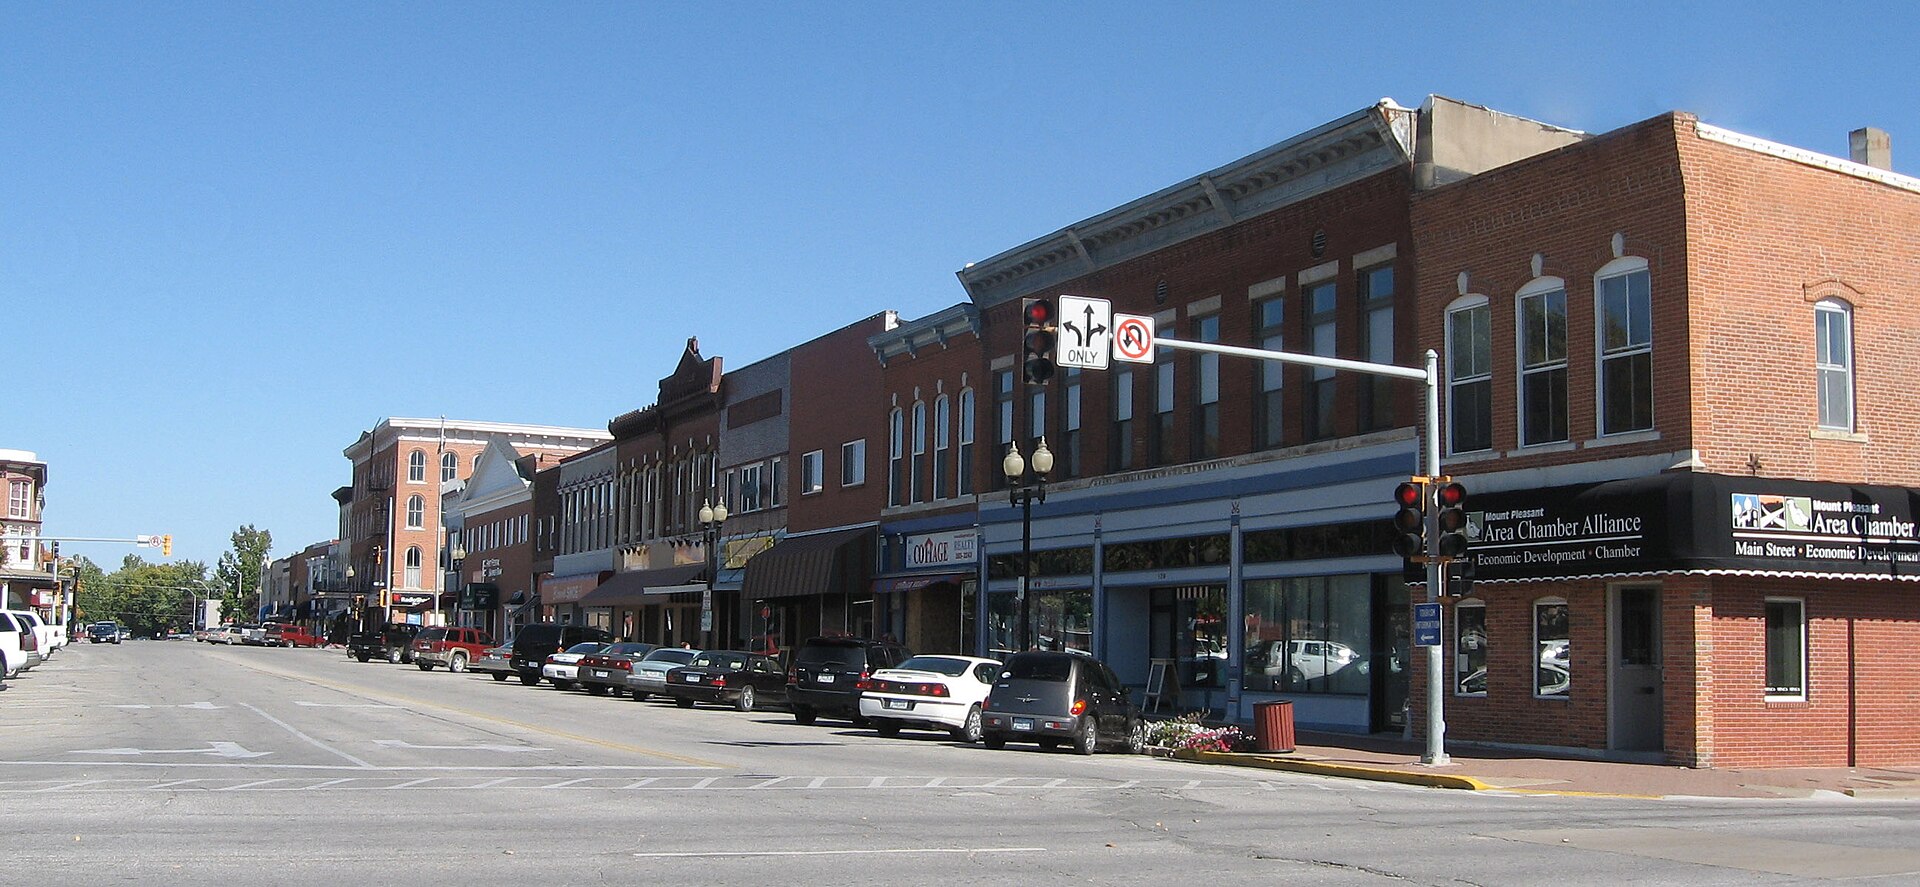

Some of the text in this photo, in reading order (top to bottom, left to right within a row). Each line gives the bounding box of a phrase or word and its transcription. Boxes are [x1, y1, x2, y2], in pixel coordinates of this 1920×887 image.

[1068, 349, 1098, 364] ONLY
[1485, 507, 1545, 521] Mount Pleasant
[1813, 500, 1880, 514] Mount Pleasant
[1484, 513, 1642, 542] Area Chamber Alliance
[1813, 512, 1848, 534] Area
[1851, 514, 1915, 538] Chamber
[914, 540, 949, 564] COTTAGE
[1477, 543, 1641, 566] Economic Development Chamber
[1735, 541, 1763, 556] Main
[1765, 541, 1797, 557] Street
[1805, 543, 1856, 560] Economic
